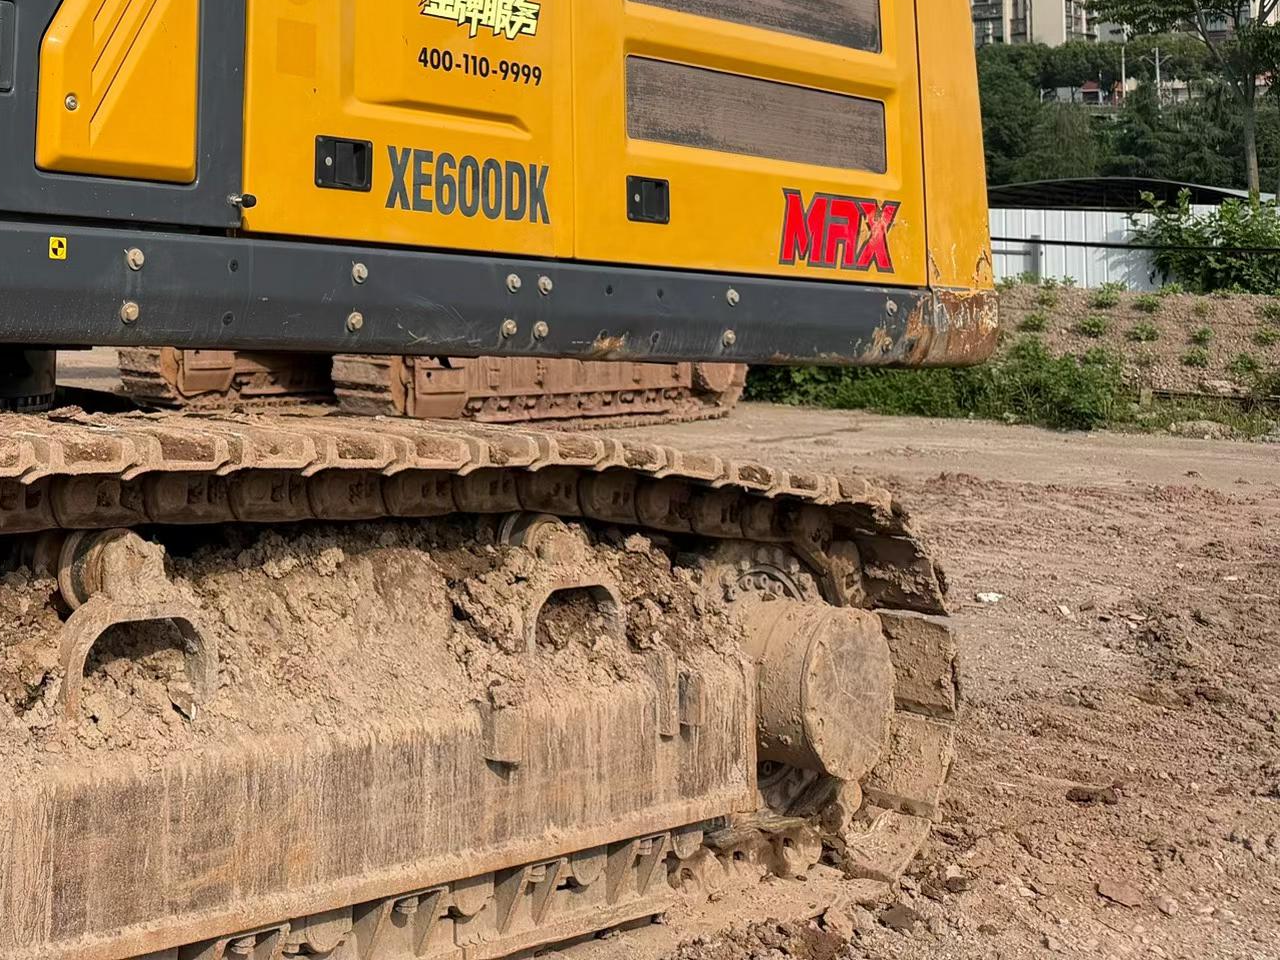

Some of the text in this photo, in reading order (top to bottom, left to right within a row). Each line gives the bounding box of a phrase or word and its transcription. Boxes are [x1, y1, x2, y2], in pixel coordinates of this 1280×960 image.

[418, 47, 542, 86] 400-110-9999
[385, 145, 550, 224] XE600DK
[779, 187, 901, 273] MAX
